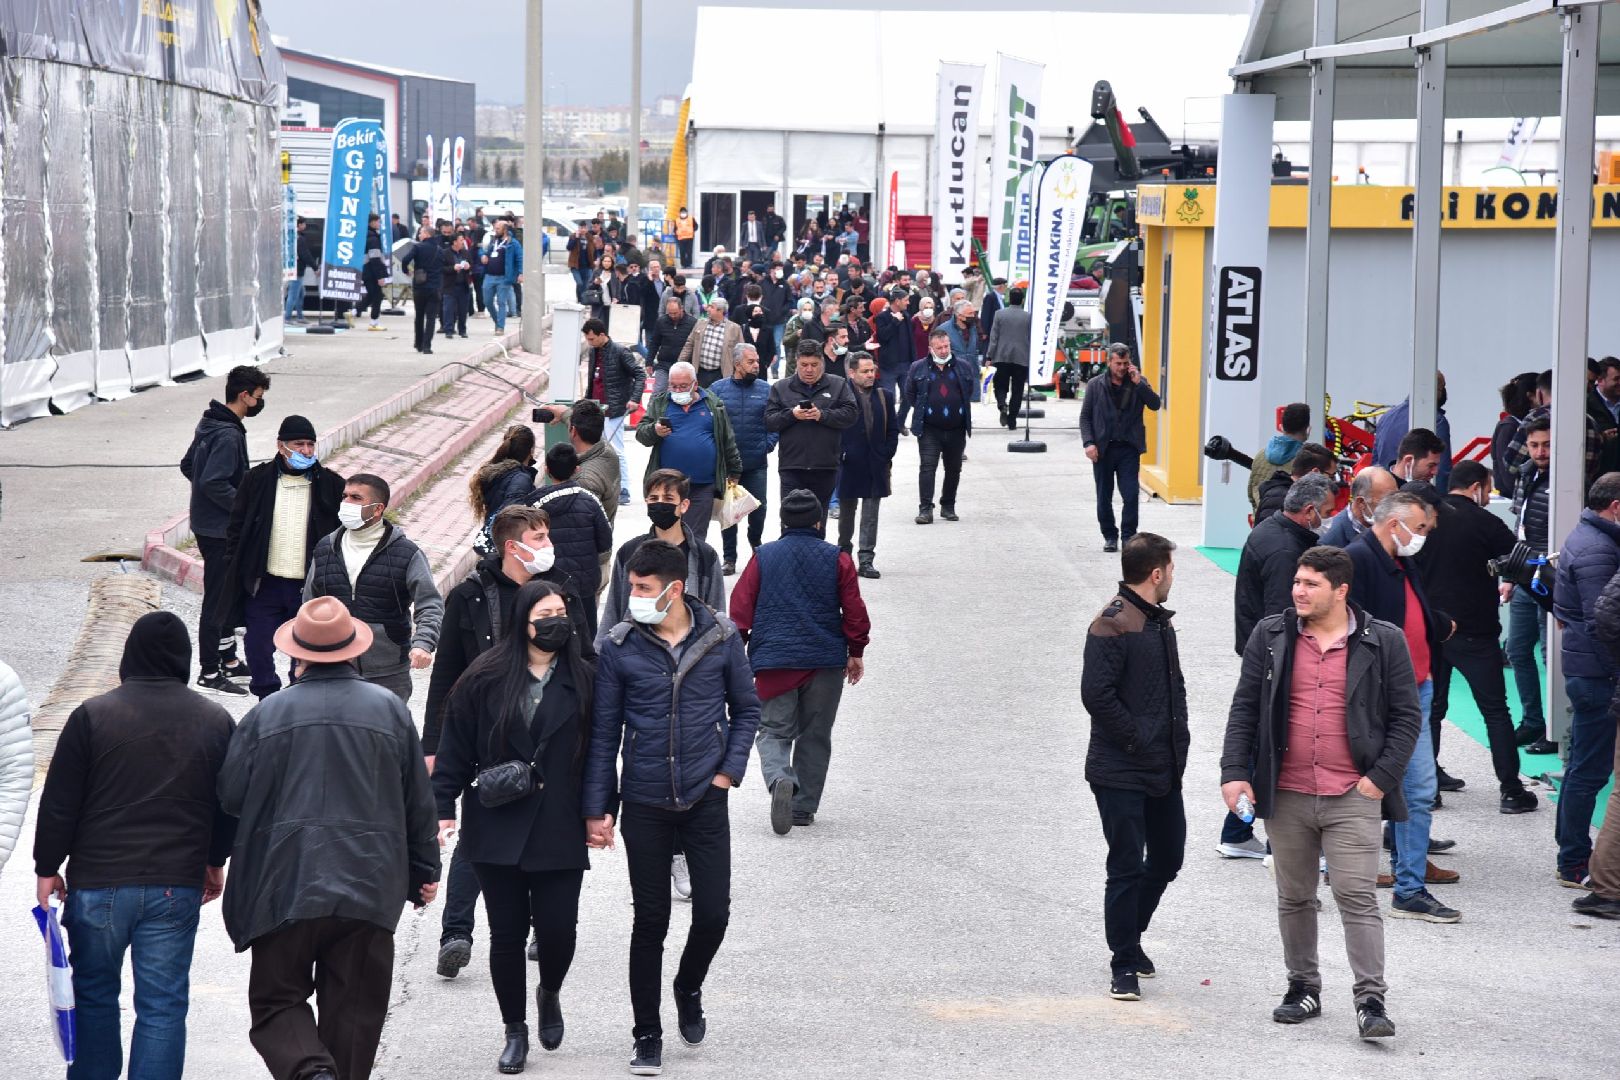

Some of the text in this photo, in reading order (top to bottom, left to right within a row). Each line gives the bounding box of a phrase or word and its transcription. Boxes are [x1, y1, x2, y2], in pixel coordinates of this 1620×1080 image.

[337, 128, 376, 149] Bekir
[949, 85, 972, 264] Kutlucan
[337, 150, 365, 264] GÜNEŞ
[1475, 191, 1620, 220] KOMN
[1042, 283, 1058, 346] KOMAN
[1224, 270, 1255, 378] ATLAS
